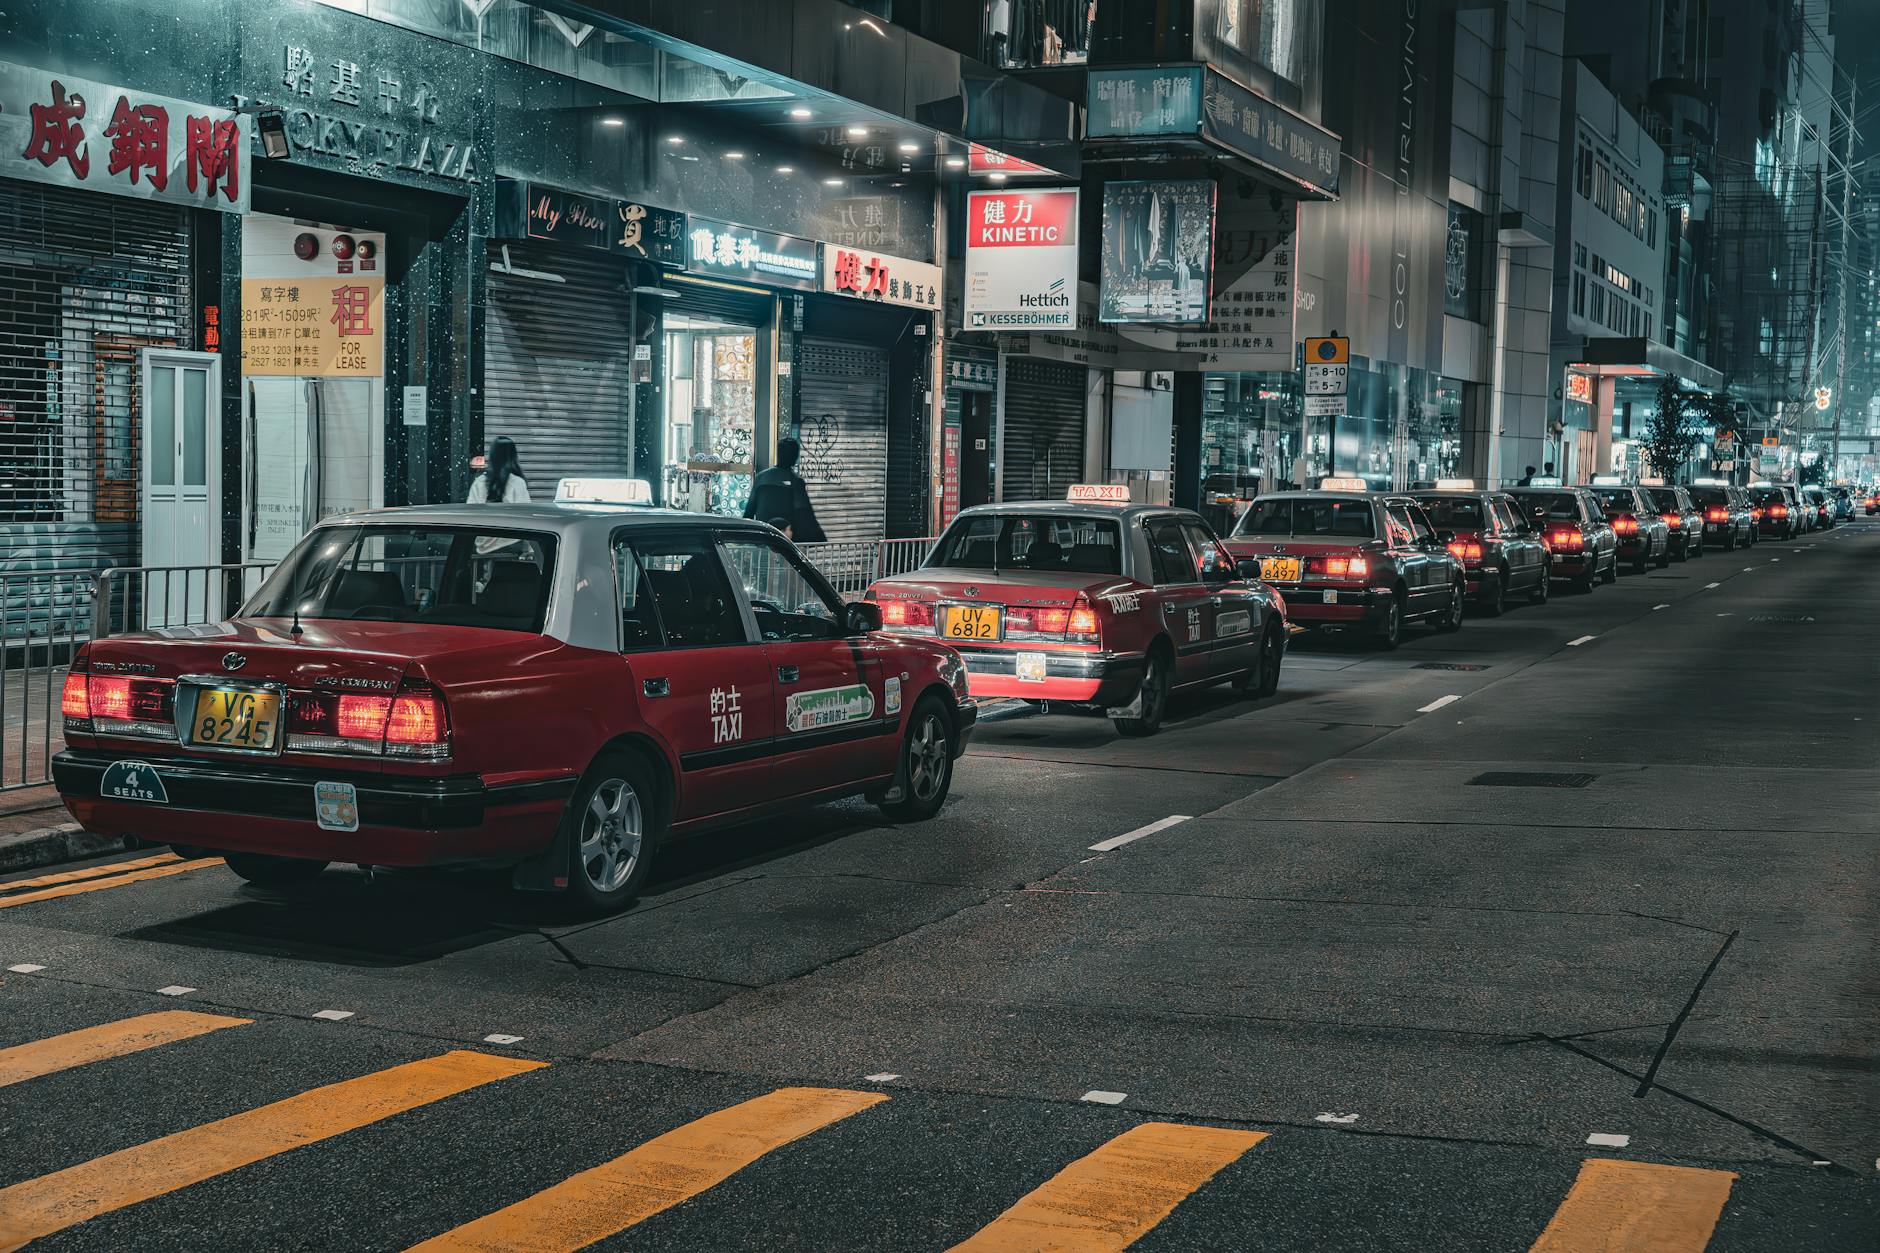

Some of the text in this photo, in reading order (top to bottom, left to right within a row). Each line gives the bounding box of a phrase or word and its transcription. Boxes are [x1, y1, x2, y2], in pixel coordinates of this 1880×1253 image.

[530, 195, 560, 232] My
[983, 200, 1033, 225] 健力
[982, 226, 1058, 243] KINETIC
[834, 250, 890, 296] 健力
[889, 278, 937, 306] 裝飾五金
[260, 285, 299, 303] 寫字樓
[1019, 294, 1069, 307] Hettich
[330, 285, 373, 338] 租
[989, 311, 1069, 325] KESSEBÖHMER
[203, 305, 219, 352] 電動
[250, 346, 270, 354] 9132
[273, 345, 292, 354] 1203
[341, 341, 361, 355] FOR
[250, 357, 270, 367] 2527
[273, 357, 291, 367] 1821
[336, 356, 367, 369] LEASE
[1321, 367, 1346, 377] 8-10
[1321, 381, 1342, 391] 5-7
[564, 481, 637, 500] TI
[1072, 486, 1124, 498] TAXI
[1272, 561, 1289, 570] KJ
[1264, 570, 1296, 580] 8497
[962, 609, 984, 623] UV
[952, 623, 991, 637] 6812
[710, 685, 741, 713] 的士
[224, 694, 256, 720] VG
[200, 718, 269, 744] 8245
[711, 713, 742, 743] TAXI
[125, 771, 139, 788] 4
[114, 786, 154, 799] SEATS
